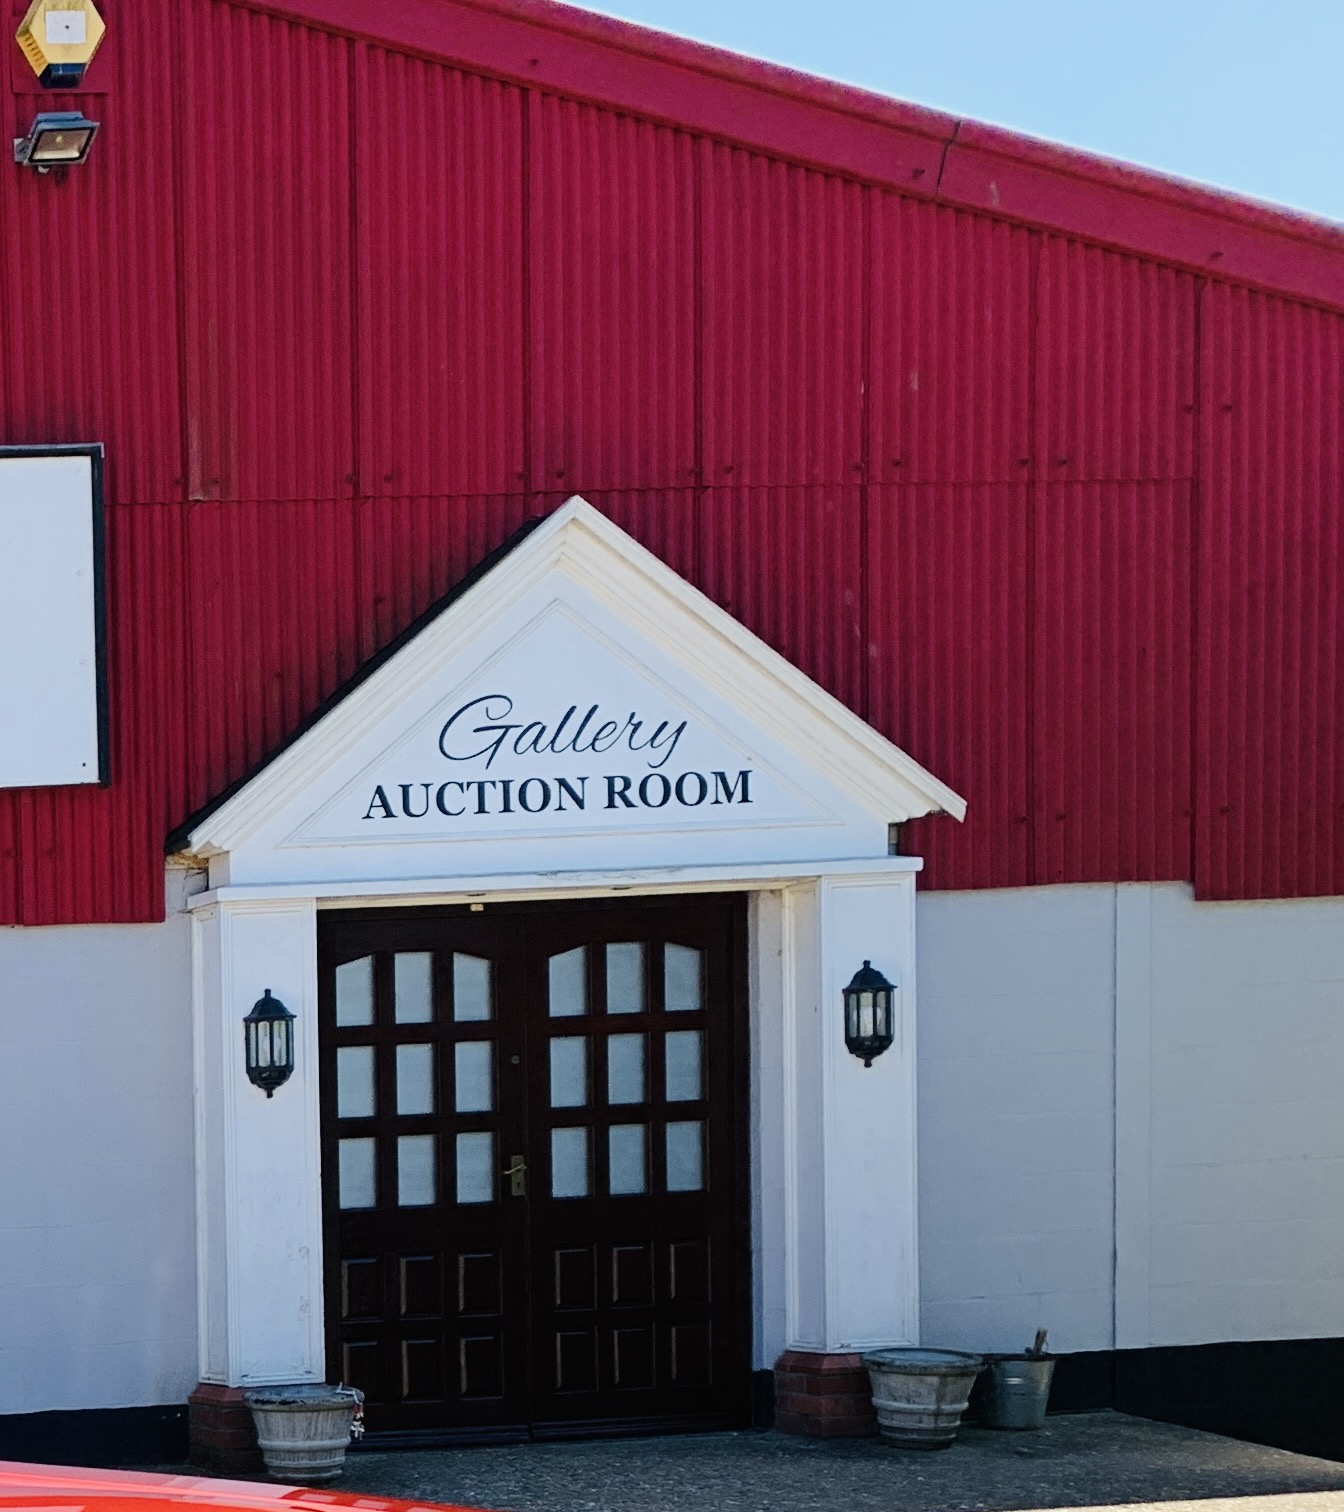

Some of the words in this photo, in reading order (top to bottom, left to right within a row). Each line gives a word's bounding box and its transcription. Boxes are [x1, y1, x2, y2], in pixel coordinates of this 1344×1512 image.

[438, 694, 688, 770] Gallery
[361, 776, 590, 820] AUCTION
[603, 769, 754, 809] ROOM
